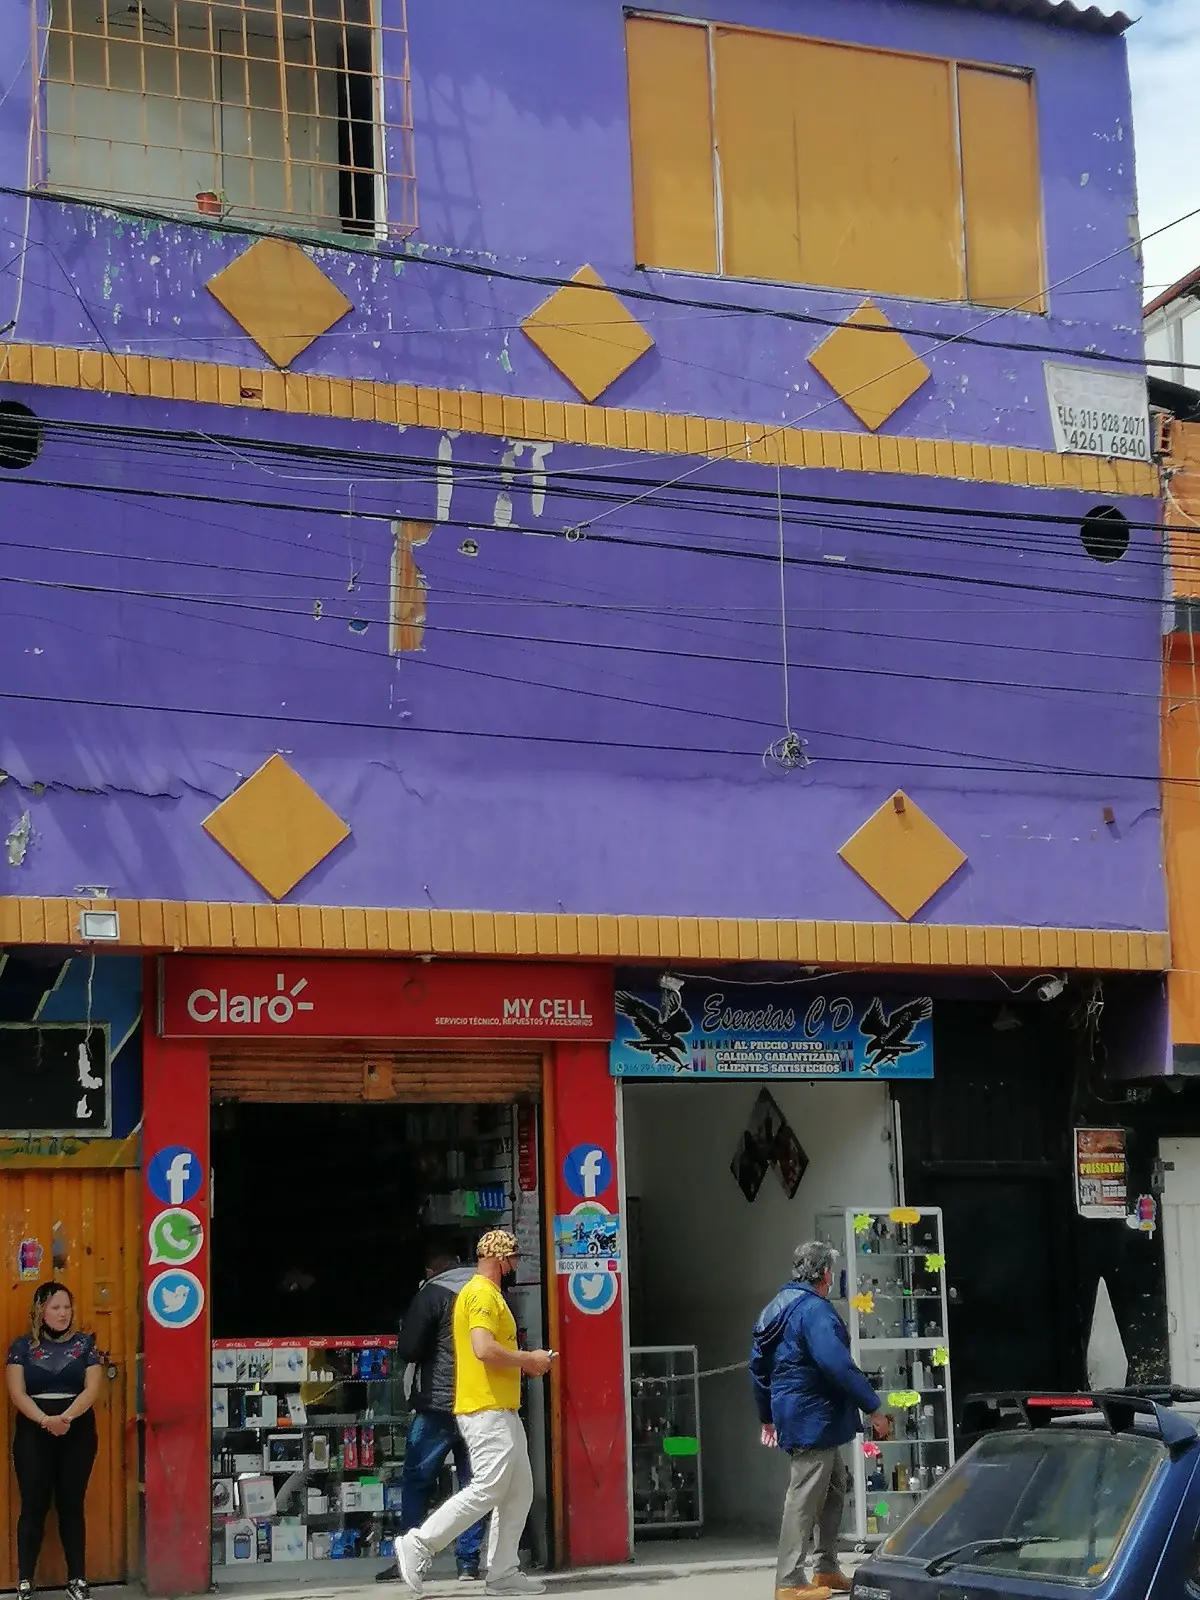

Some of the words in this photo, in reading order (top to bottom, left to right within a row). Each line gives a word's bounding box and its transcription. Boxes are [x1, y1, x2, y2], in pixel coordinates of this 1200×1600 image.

[1080, 410, 1098, 430] 315
[1102, 412, 1119, 433] 828
[1122, 415, 1145, 437] 2071
[1111, 436, 1145, 457] 6840
[187, 987, 294, 1023] Claro
[504, 998, 533, 1019] MY
[539, 998, 592, 1019] CELL
[701, 993, 796, 1034] Esencias
[435, 1017, 468, 1025] SERVICIO
[502, 1017, 543, 1026] REPUESTOS
[550, 1018, 593, 1026] ACCESORIOS
[733, 1041, 748, 1050] AL
[750, 1041, 789, 1050] PRECIO
[790, 1041, 823, 1050] JUSTO
[716, 1052, 762, 1062] CALIDAD
[764, 1052, 841, 1062] GARANTIZADA
[716, 1063, 769, 1073] CLIENTES
[771, 1063, 840, 1073] SATISFECHOS
